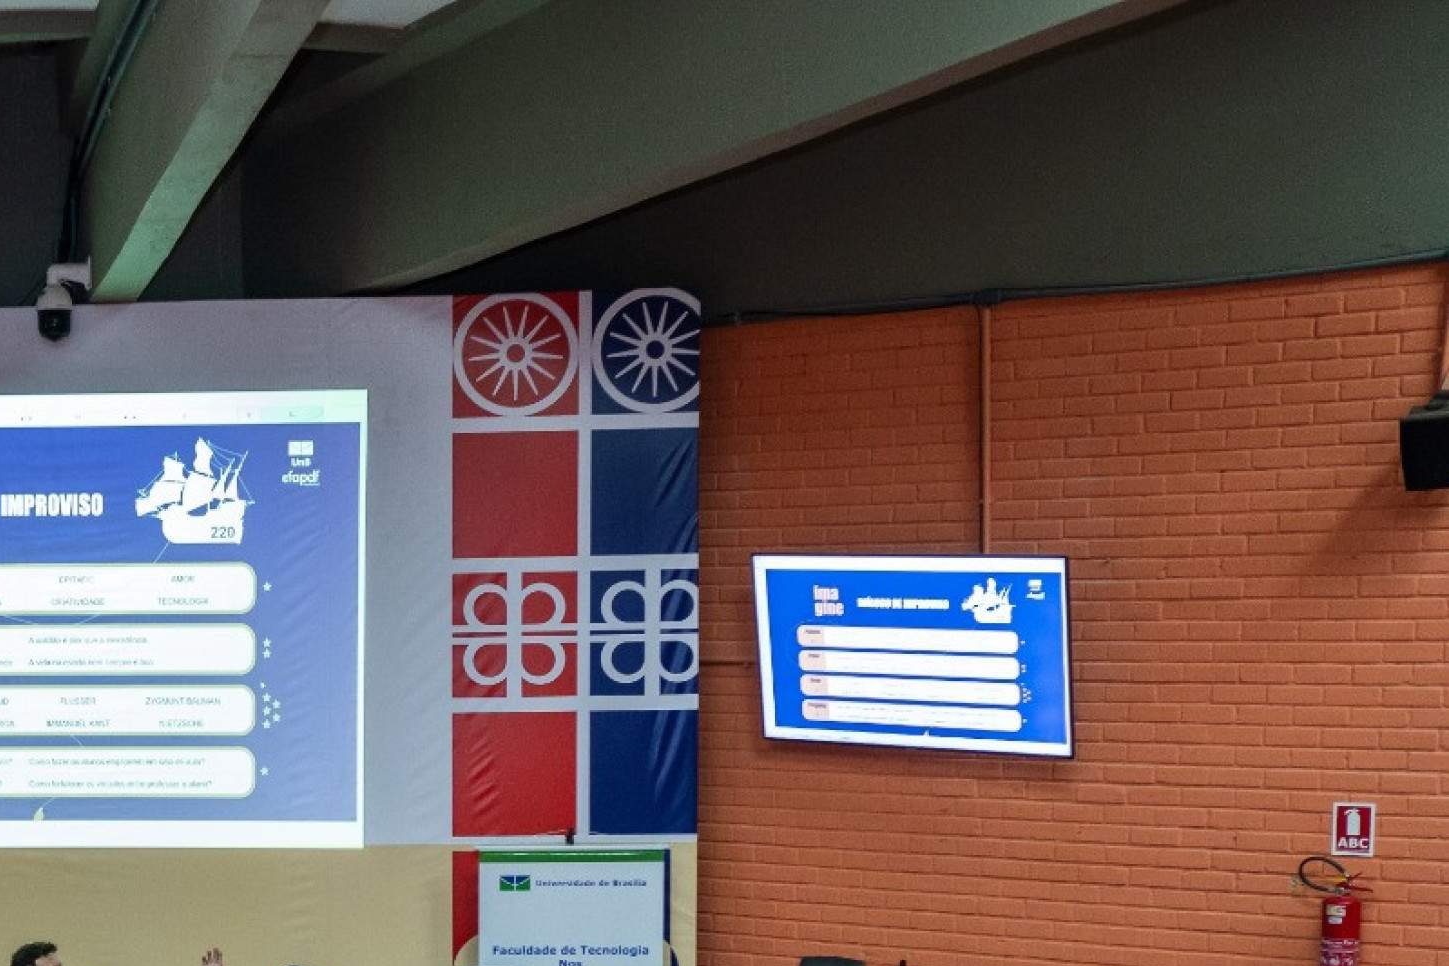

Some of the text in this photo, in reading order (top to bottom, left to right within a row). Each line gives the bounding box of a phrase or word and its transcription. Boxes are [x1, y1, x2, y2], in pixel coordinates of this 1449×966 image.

[0, 493, 105, 518] IMPROVISO
[210, 525, 236, 539] 220
[1337, 837, 1369, 849] ABC
[535, 879, 596, 887] Universidade
[599, 879, 610, 887] de
[493, 945, 650, 957] Faculdade de Tecnologia
